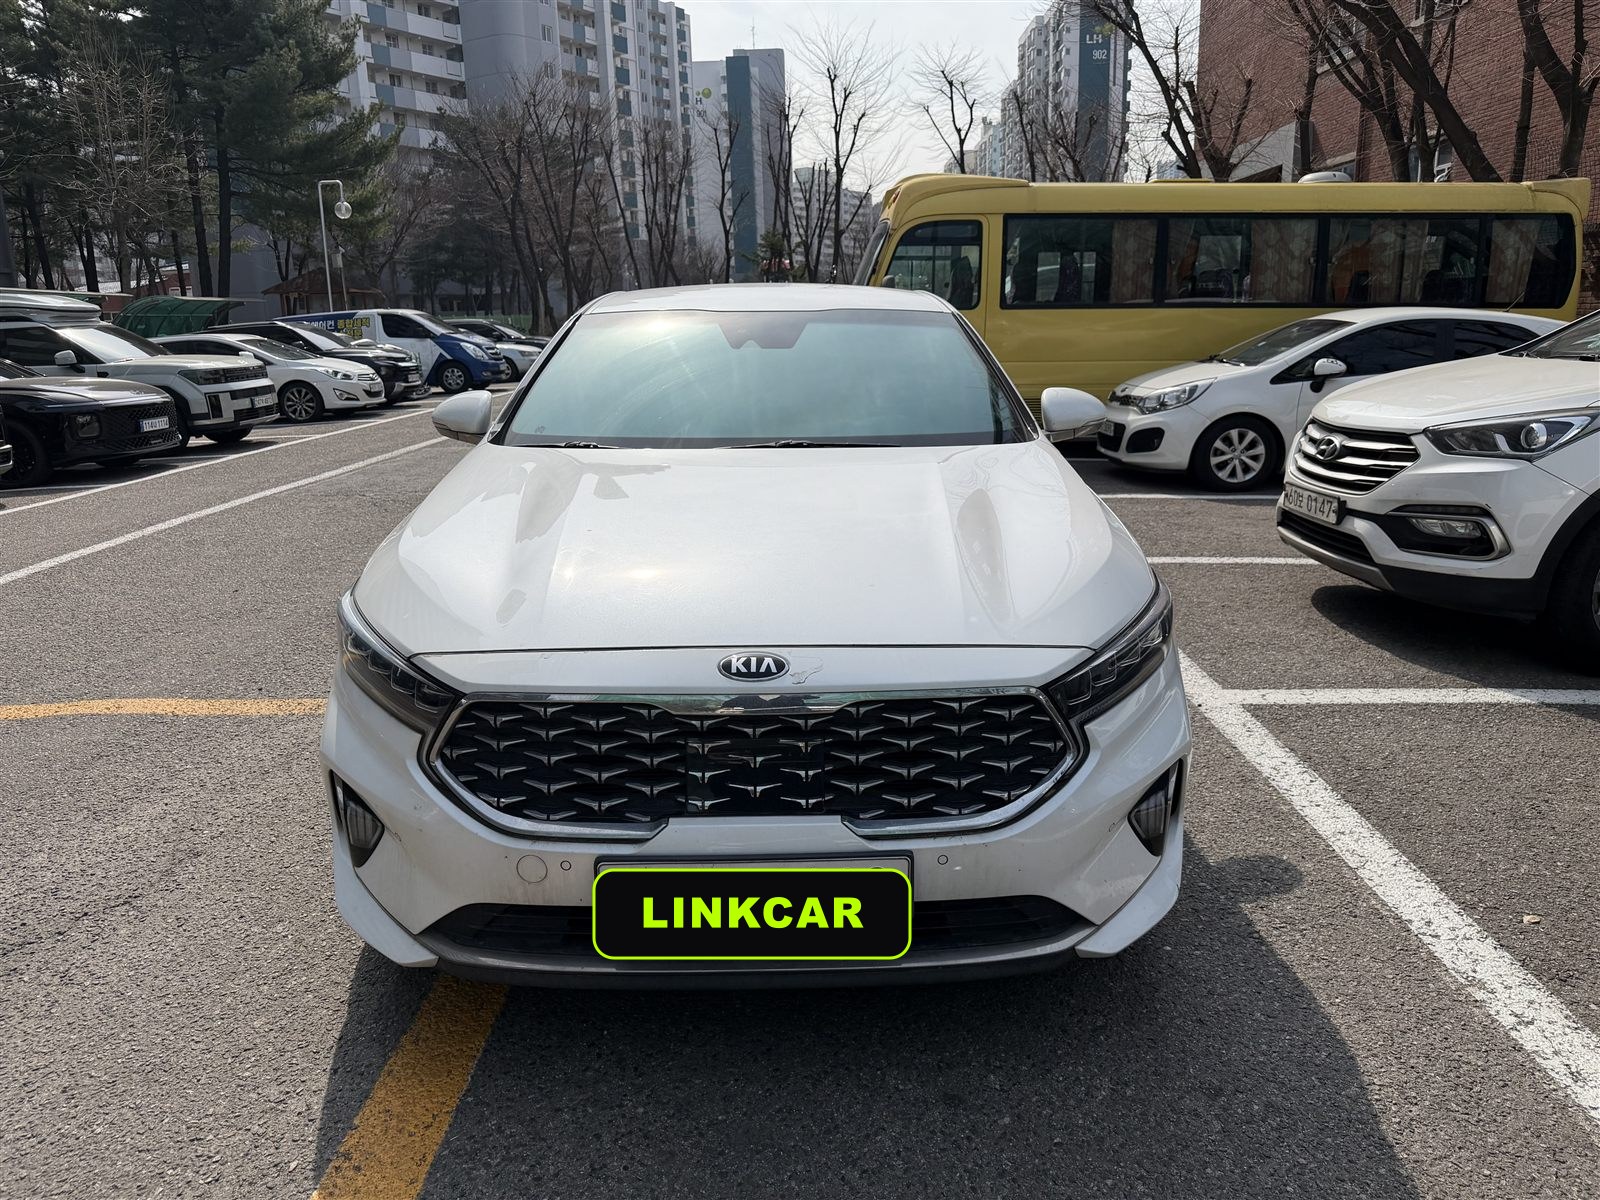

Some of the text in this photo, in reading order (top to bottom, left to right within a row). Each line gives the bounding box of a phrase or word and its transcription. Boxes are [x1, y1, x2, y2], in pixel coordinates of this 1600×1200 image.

[1086, 34, 1102, 44] LH
[1092, 49, 1107, 60] 902
[1306, 494, 1333, 518] 0147
[730, 655, 778, 674] KIA
